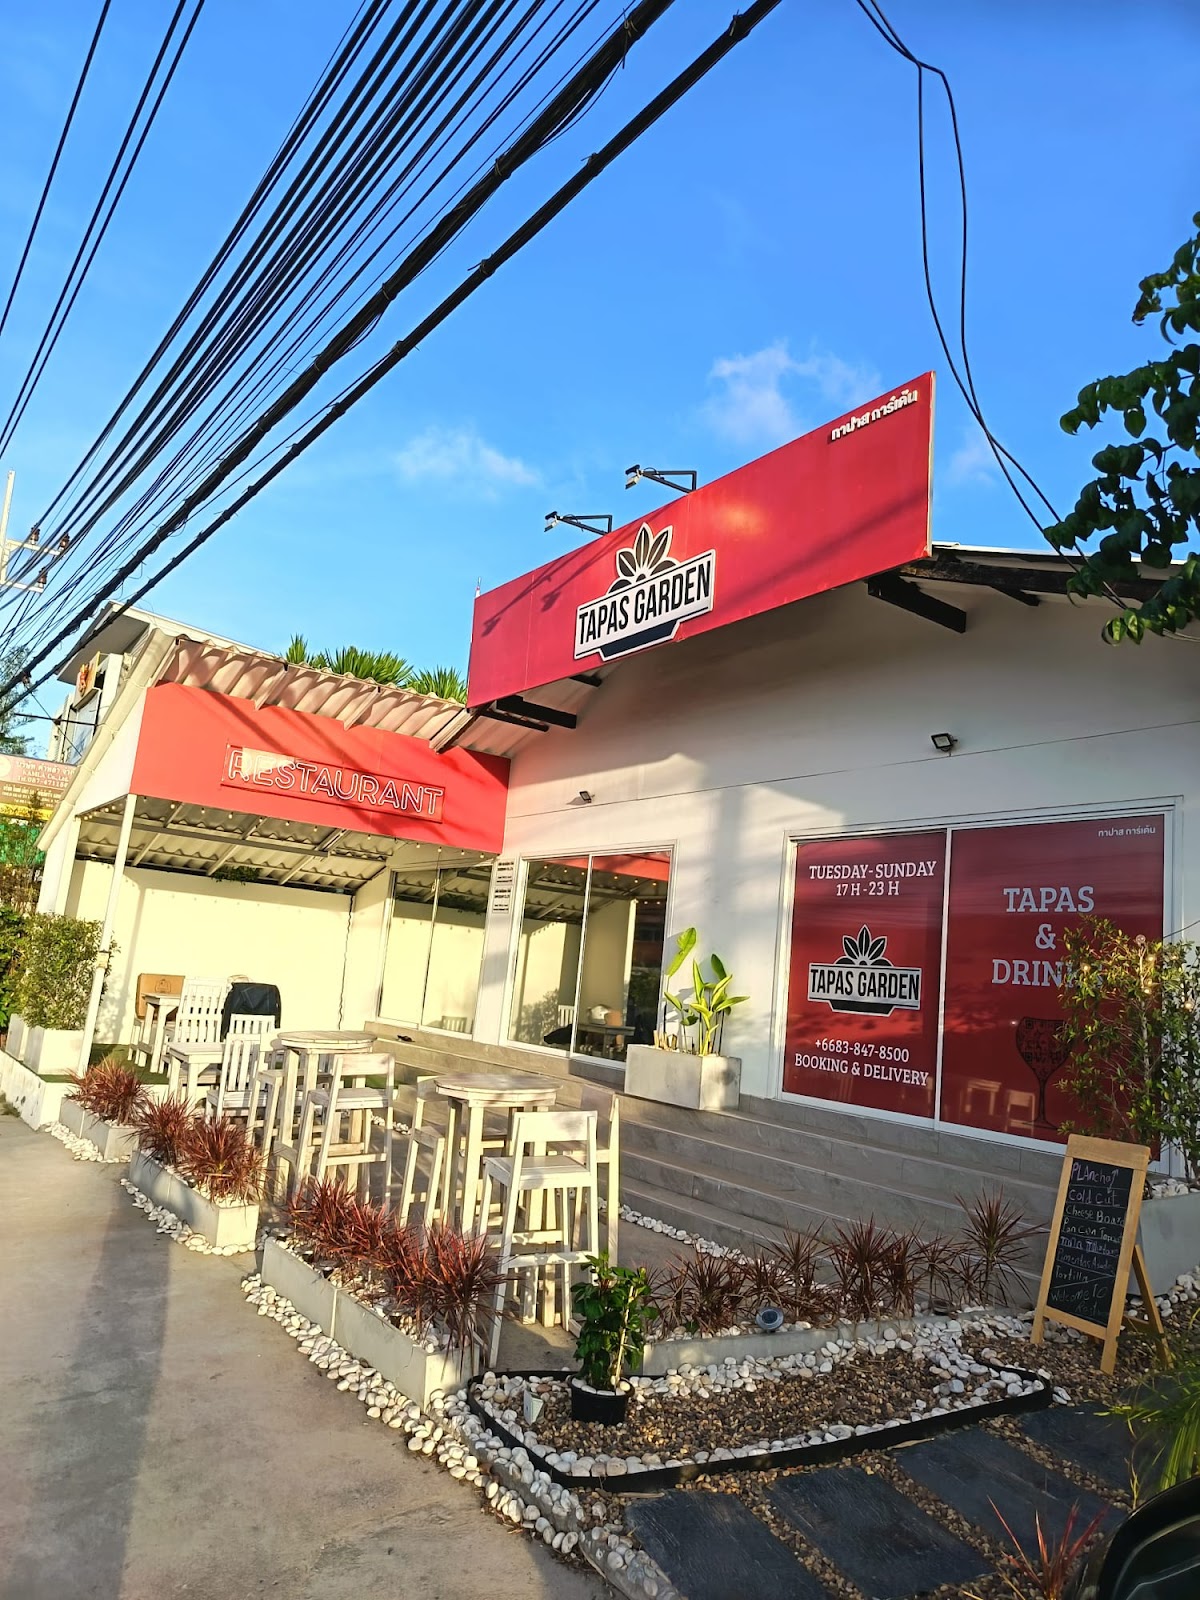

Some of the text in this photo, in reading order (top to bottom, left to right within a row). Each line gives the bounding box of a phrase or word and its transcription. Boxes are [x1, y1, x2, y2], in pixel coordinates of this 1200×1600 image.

[578, 560, 712, 645] TAPAS GARDEN
[228, 750, 444, 815] RESTAURANT
[1003, 885, 1095, 913] TAPAS
[1035, 923, 1056, 950] &
[810, 969, 920, 1001] TAPAS GARDEN
[991, 958, 1104, 988] DRIN
[815, 1037, 910, 1063] +6683-847-8500
[794, 1053, 929, 1086] BOOKING & DELIVERY
